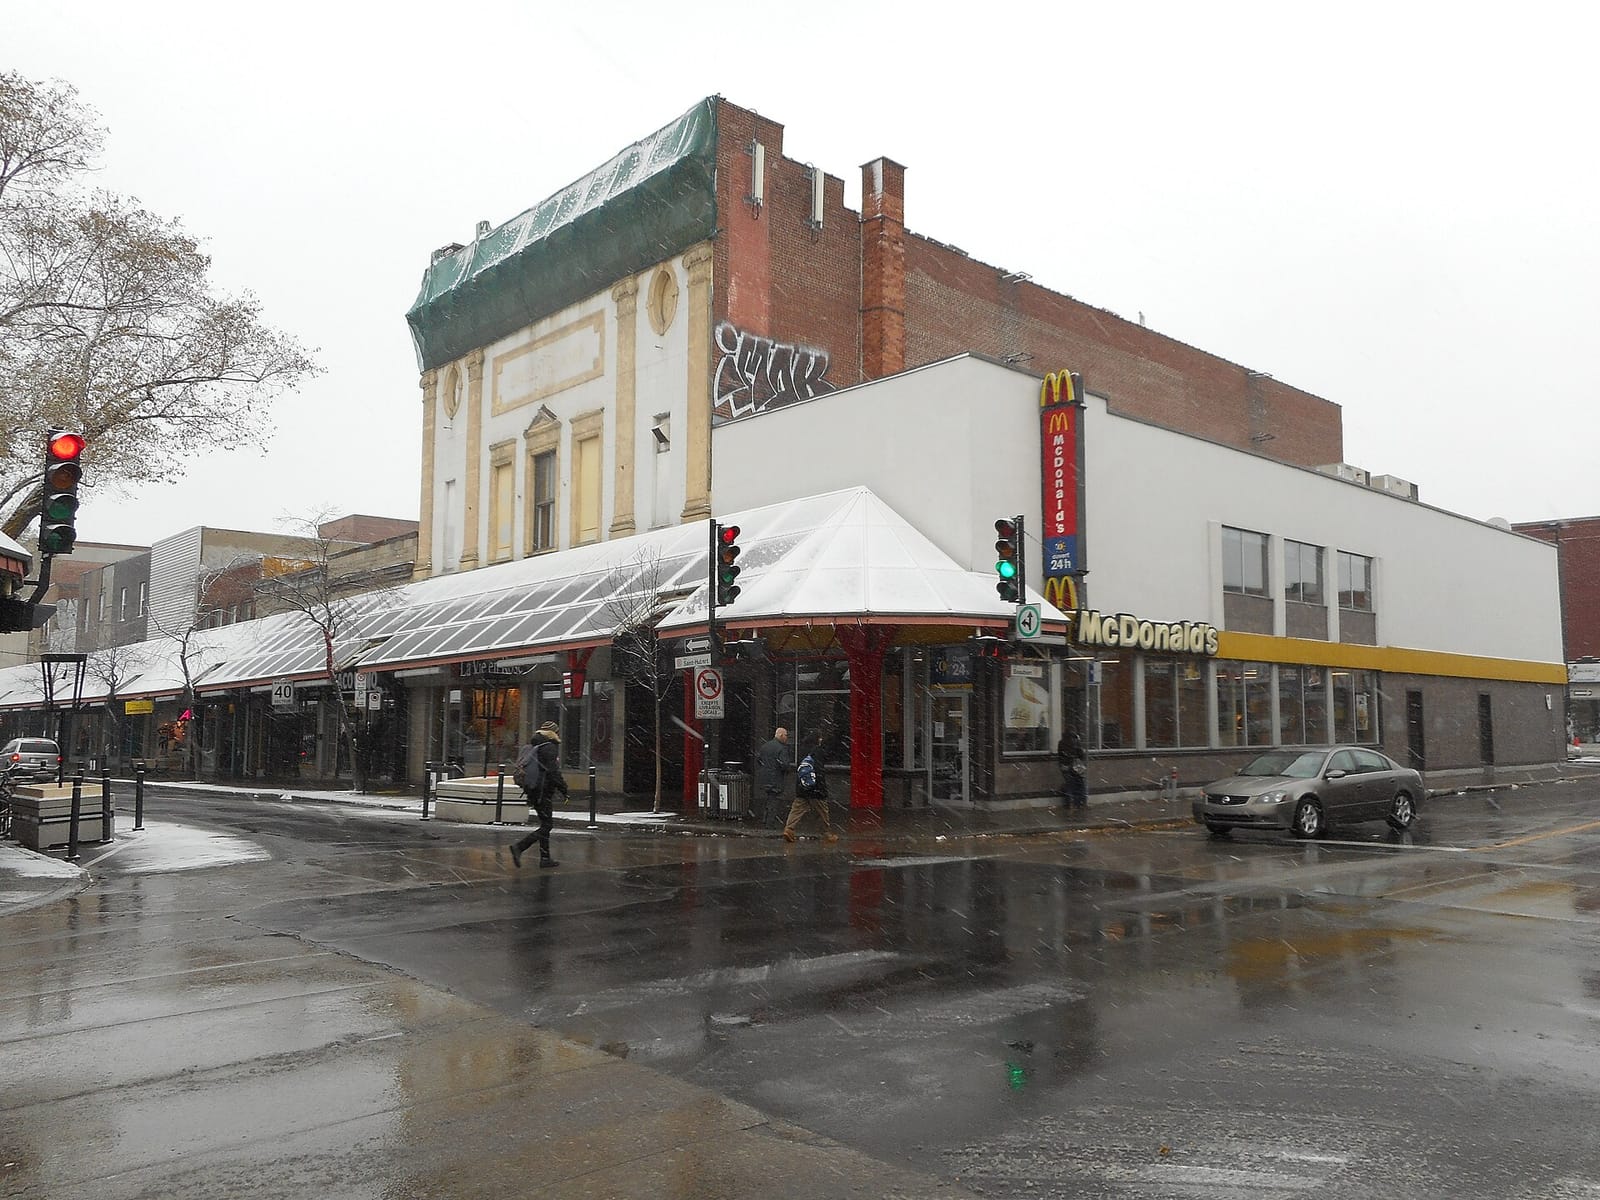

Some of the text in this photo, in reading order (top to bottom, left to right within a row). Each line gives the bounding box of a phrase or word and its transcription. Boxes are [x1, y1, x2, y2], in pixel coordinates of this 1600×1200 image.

[1053, 434, 1065, 534] McDonald's
[1078, 609, 1219, 656] McDonald's
[273, 685, 292, 698] 40
